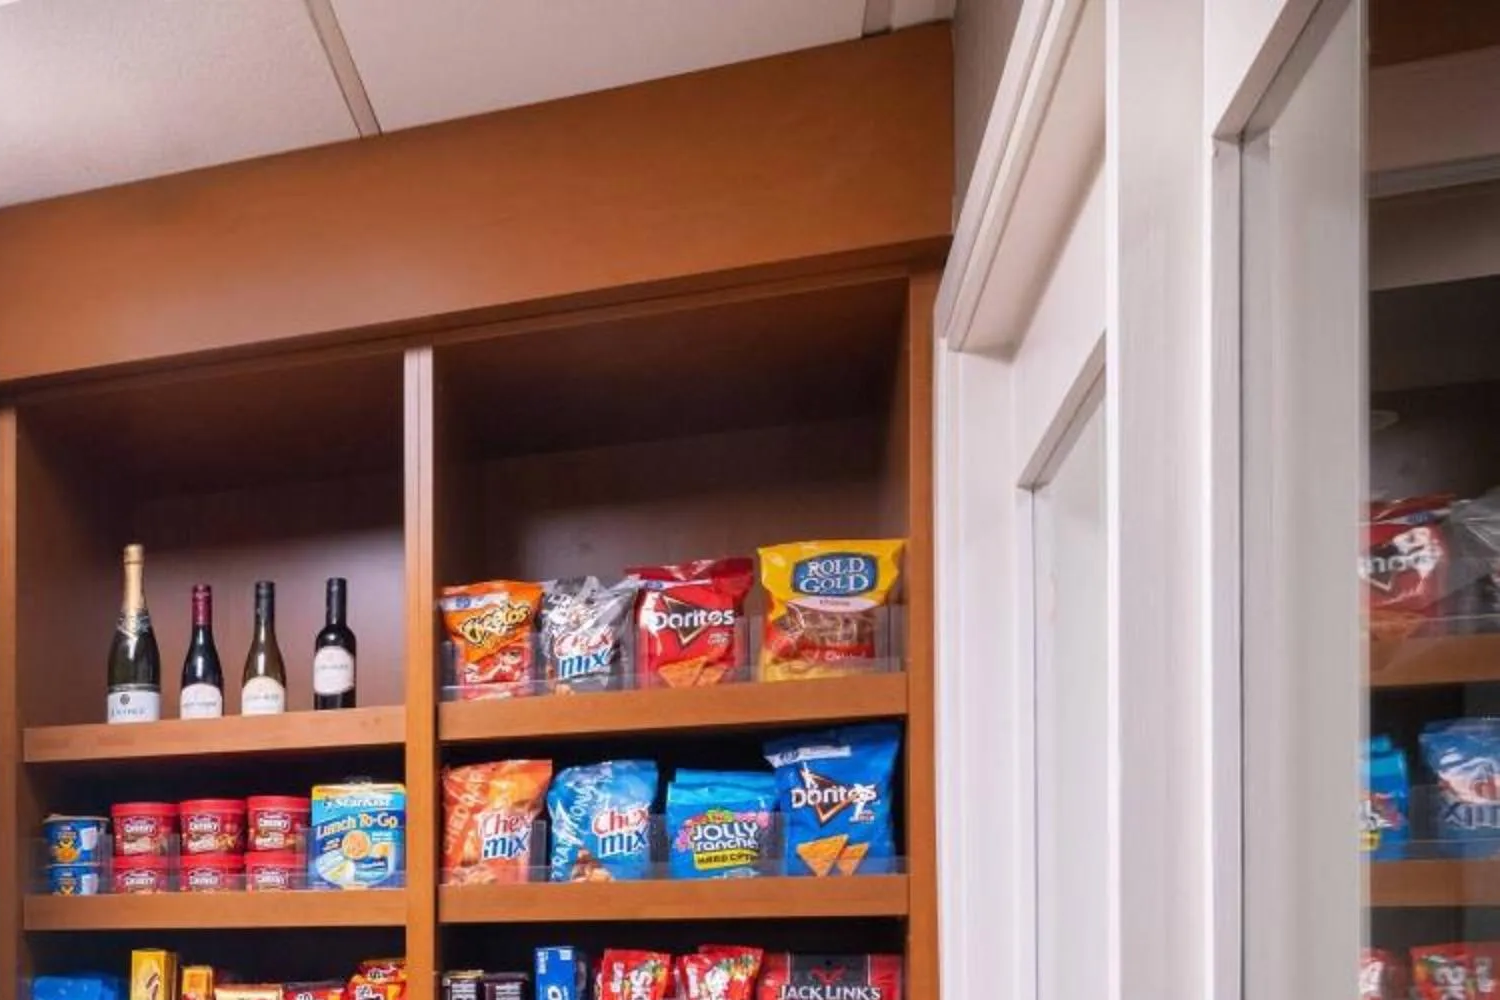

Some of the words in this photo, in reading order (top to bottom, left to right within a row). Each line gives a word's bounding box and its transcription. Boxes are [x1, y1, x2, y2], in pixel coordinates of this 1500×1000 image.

[808, 557, 867, 577] ROLD
[800, 574, 869, 593] GOLD
[651, 608, 735, 630] Doritos
[791, 783, 878, 809] Doritos
[694, 821, 759, 842] JOLLY
[778, 985, 824, 1000] JACK
